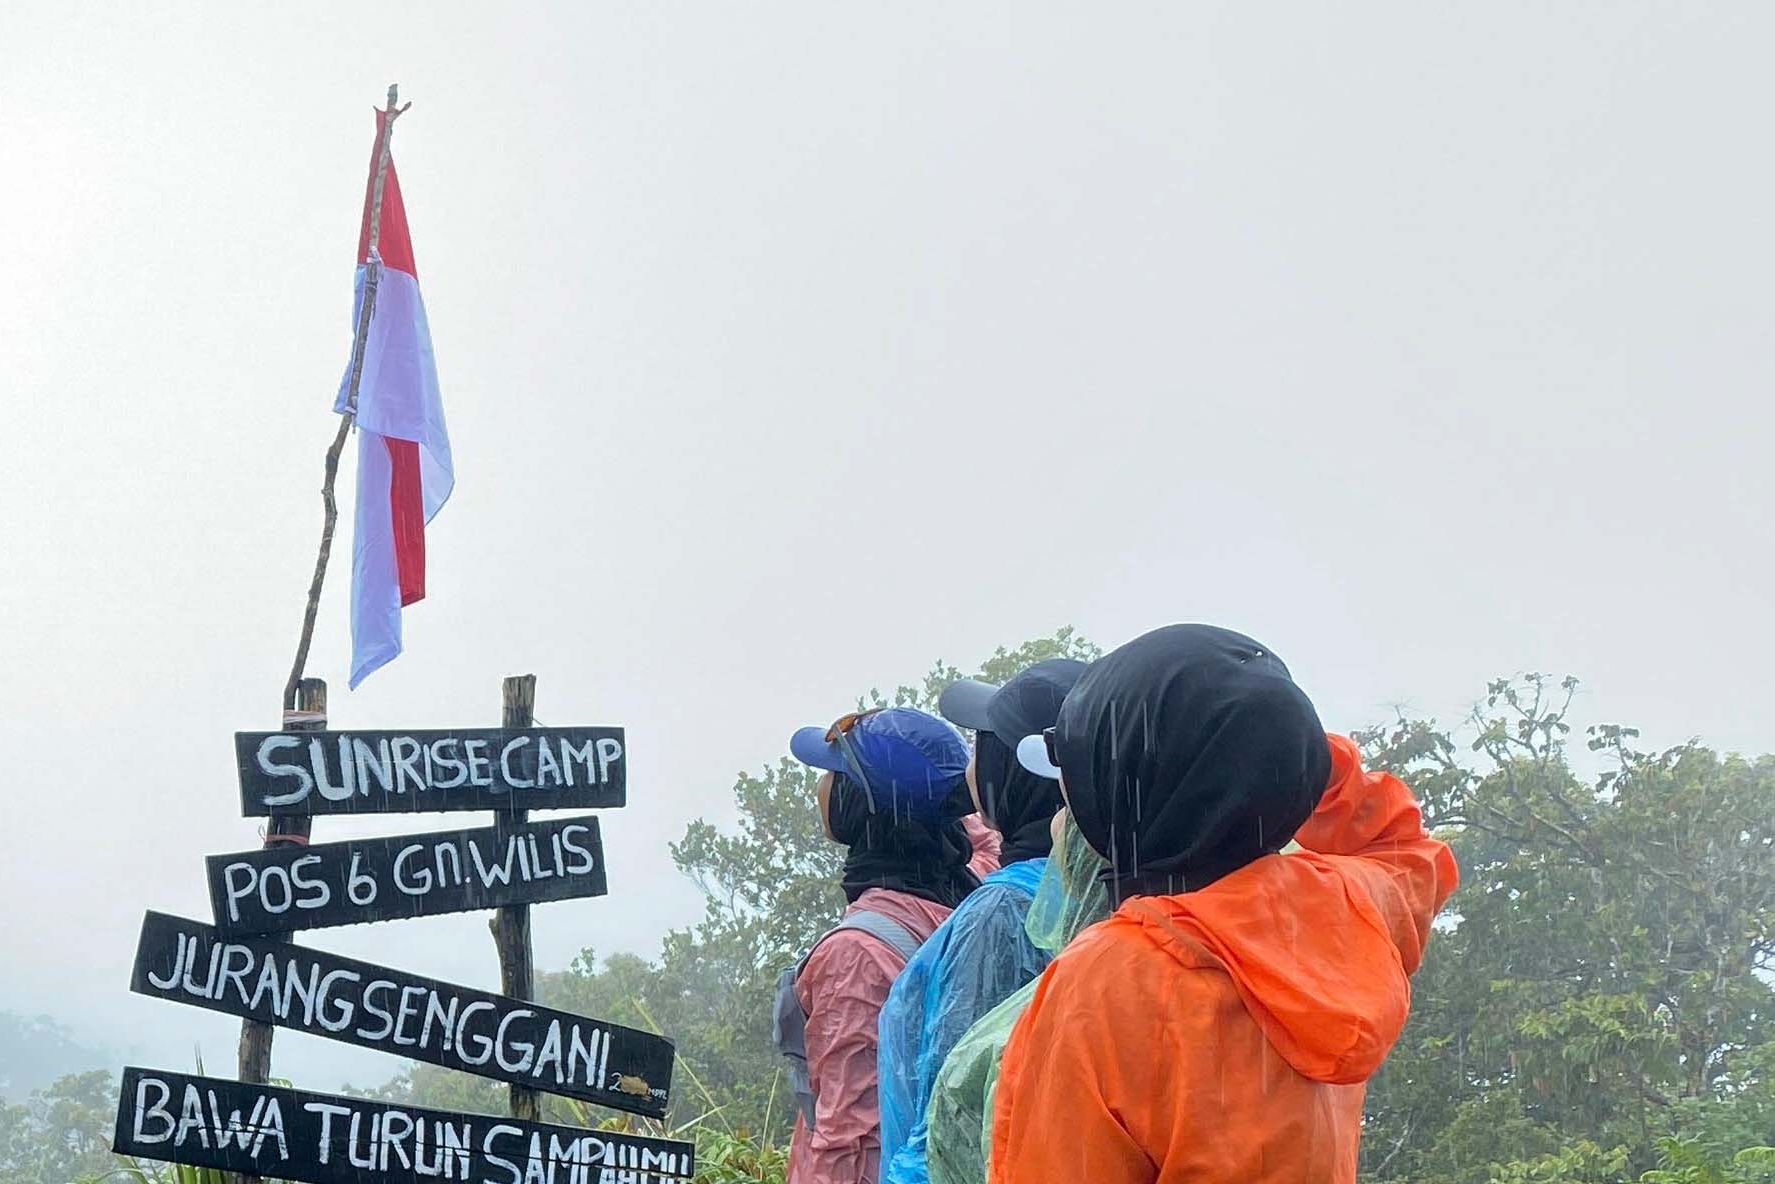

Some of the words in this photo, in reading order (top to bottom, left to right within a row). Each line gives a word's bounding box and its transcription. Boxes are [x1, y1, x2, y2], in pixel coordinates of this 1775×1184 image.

[256, 733, 493, 806] SUNRISE
[500, 735, 623, 789] CAMP
[224, 853, 331, 922] POS
[347, 851, 378, 906] 6
[132, 1076, 289, 1161] BAWA
[303, 1101, 473, 1181] TURUN
